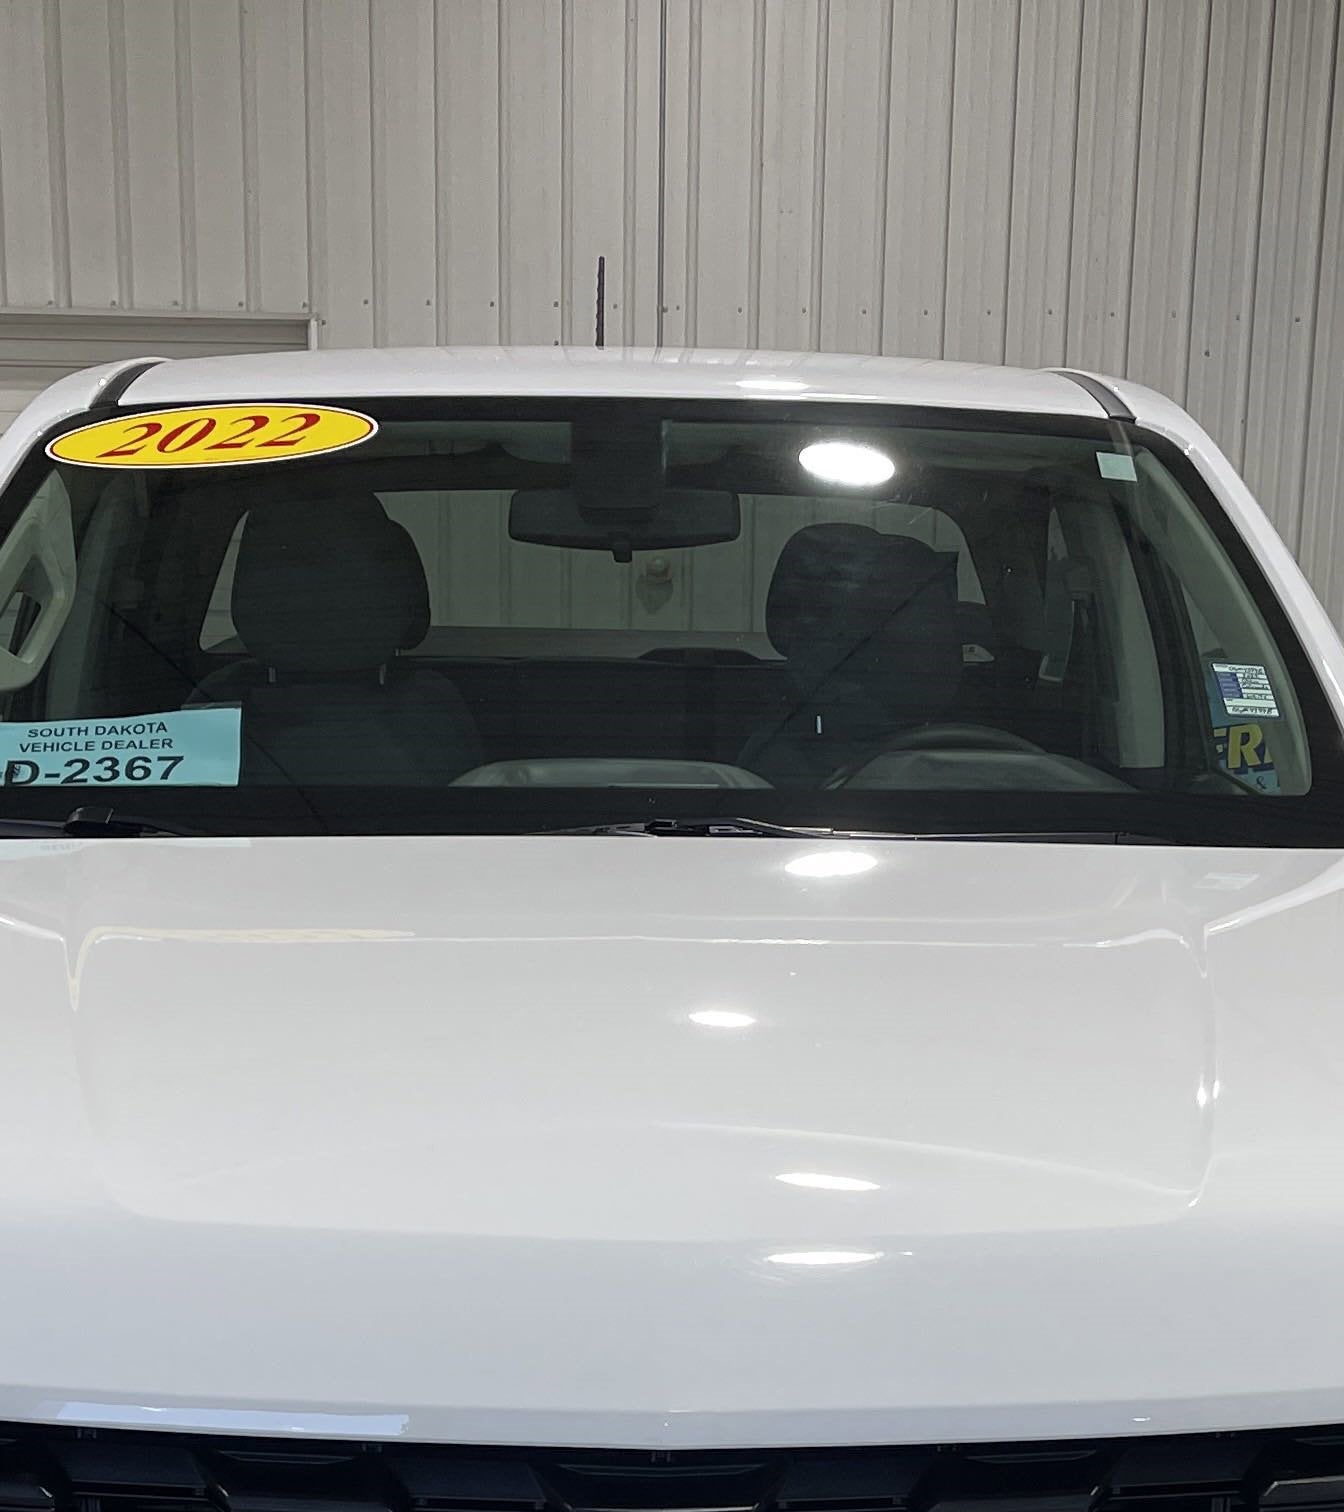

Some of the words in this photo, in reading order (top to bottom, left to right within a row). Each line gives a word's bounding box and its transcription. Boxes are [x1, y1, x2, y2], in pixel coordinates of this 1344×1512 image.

[96, 413, 321, 458] 2022
[27, 726, 89, 738] SOUTH
[95, 722, 168, 736] DAKOTA
[19, 740, 95, 753] VEHICLE
[101, 738, 174, 750] DEALER
[5, 756, 184, 785] D-2367
